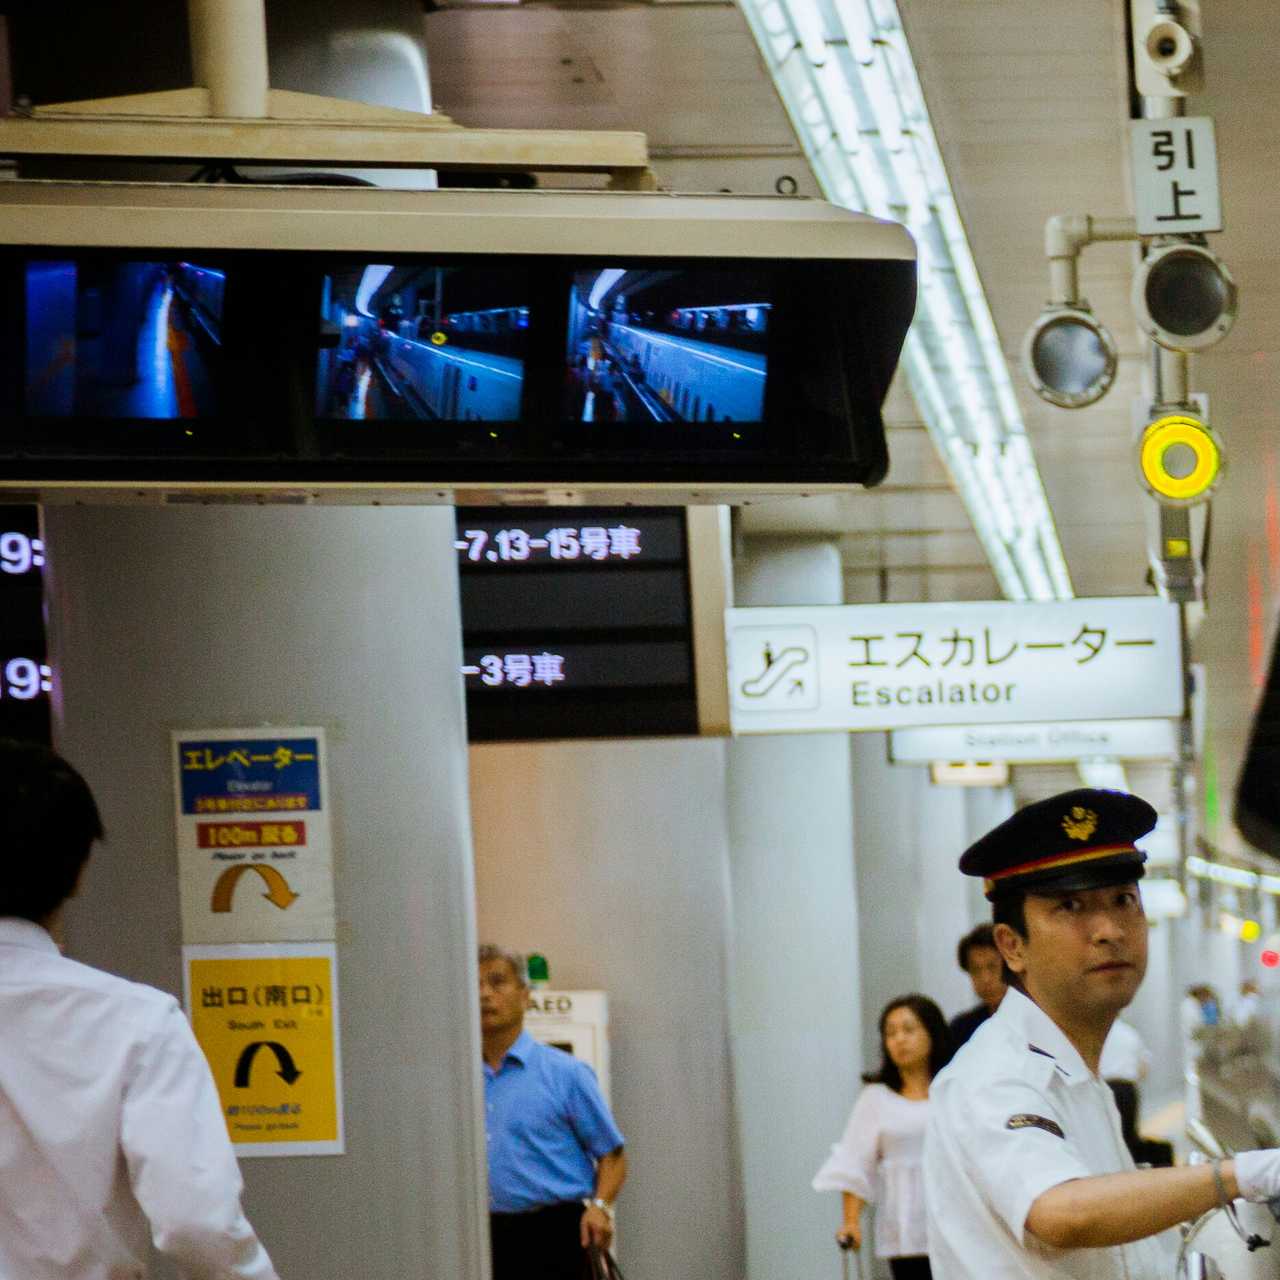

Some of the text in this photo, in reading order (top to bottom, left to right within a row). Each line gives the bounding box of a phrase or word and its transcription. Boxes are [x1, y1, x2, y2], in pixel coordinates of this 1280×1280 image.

[1150, 128, 1203, 222] 引上
[848, 624, 1156, 668] エスカレーター
[852, 680, 1017, 708] Escalator
[183, 745, 315, 771] エレベーター
